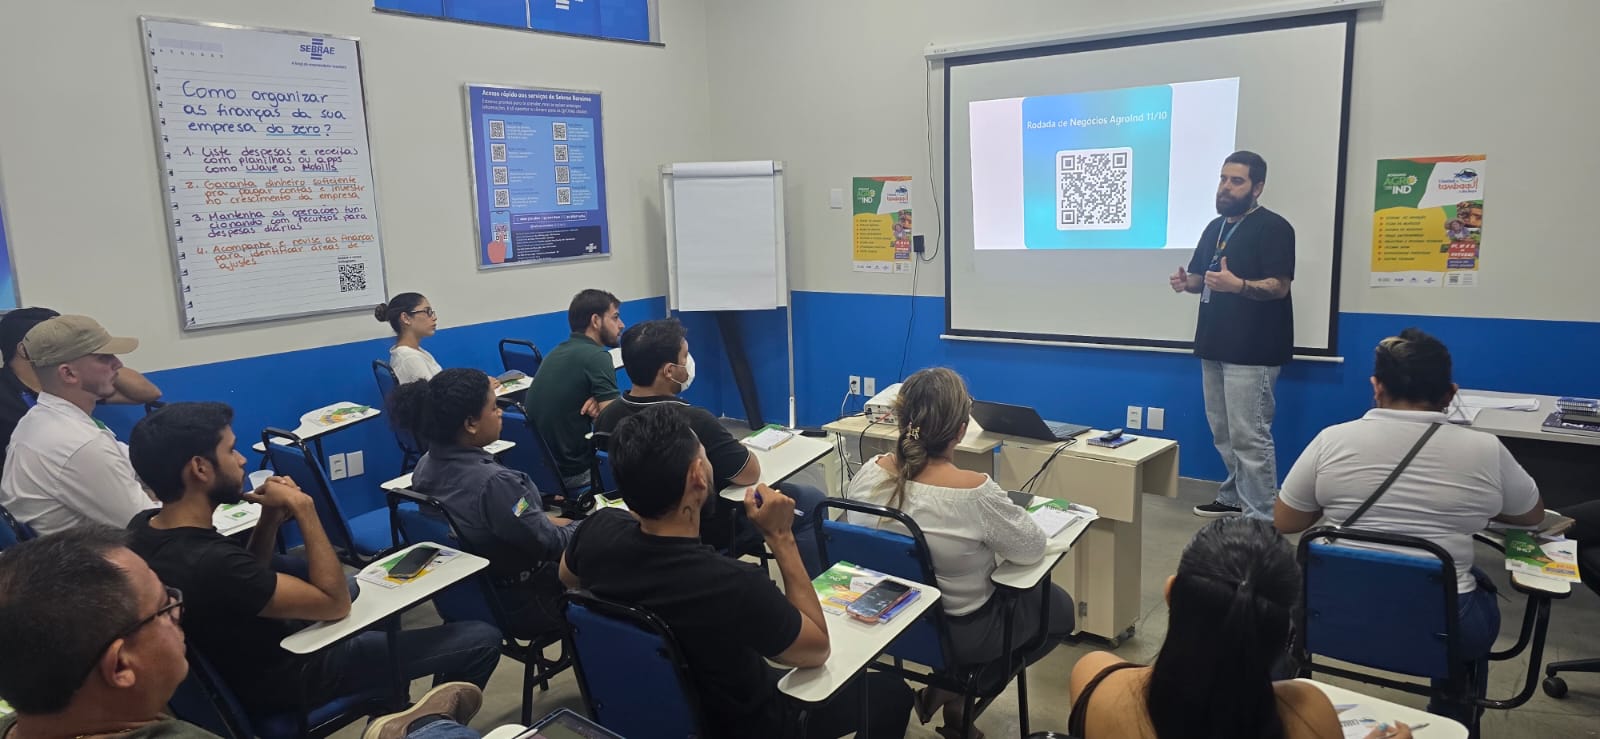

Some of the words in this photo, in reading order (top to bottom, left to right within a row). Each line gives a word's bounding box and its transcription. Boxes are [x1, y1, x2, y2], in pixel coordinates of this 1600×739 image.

[300, 44, 335, 55] SEBRAE
[182, 80, 237, 99] Como
[251, 89, 328, 108] organizar
[183, 104, 207, 116] as
[217, 103, 281, 123] finanças
[291, 108, 311, 119] da
[320, 109, 346, 120] sua
[1027, 119, 1056, 129] Rodada
[1057, 119, 1068, 128] de
[1069, 116, 1108, 128] Negócios
[1109, 113, 1144, 126] AgroInd
[1146, 111, 1168, 122] 11/10
[188, 120, 257, 135] empresa
[266, 123, 284, 135] do
[183, 146, 195, 157] 1.
[201, 146, 232, 157] Liste
[241, 146, 292, 159] despesas
[314, 146, 359, 156] receitas
[203, 156, 231, 164] com
[238, 156, 292, 166] planilhas
[298, 156, 311, 164] ou
[317, 156, 343, 167] apps
[205, 165, 238, 173] como
[185, 181, 199, 189] 2.
[204, 178, 257, 190] Garanta
[265, 177, 306, 187] dinheiro
[1392, 185, 1412, 195] IND
[205, 189, 228, 199] pra
[239, 188, 273, 198] pagar
[279, 185, 313, 194] contas
[331, 184, 366, 193] investir
[230, 195, 291, 204] crescimento
[319, 191, 360, 201] empresa
[192, 214, 204, 222] 3.
[208, 210, 266, 222] Mantenha
[272, 209, 284, 217] as
[291, 205, 340, 218] operações
[209, 219, 263, 230] cionando
[270, 217, 290, 226] com
[299, 214, 339, 223] recursos
[344, 213, 368, 222] para
[207, 227, 256, 239] despesas
[264, 223, 303, 233] diárias
[213, 241, 272, 254] Acompanhe
[291, 237, 321, 246] revise
[214, 252, 244, 265] para
[249, 246, 304, 258] identificar
[219, 257, 257, 272] ajustes
